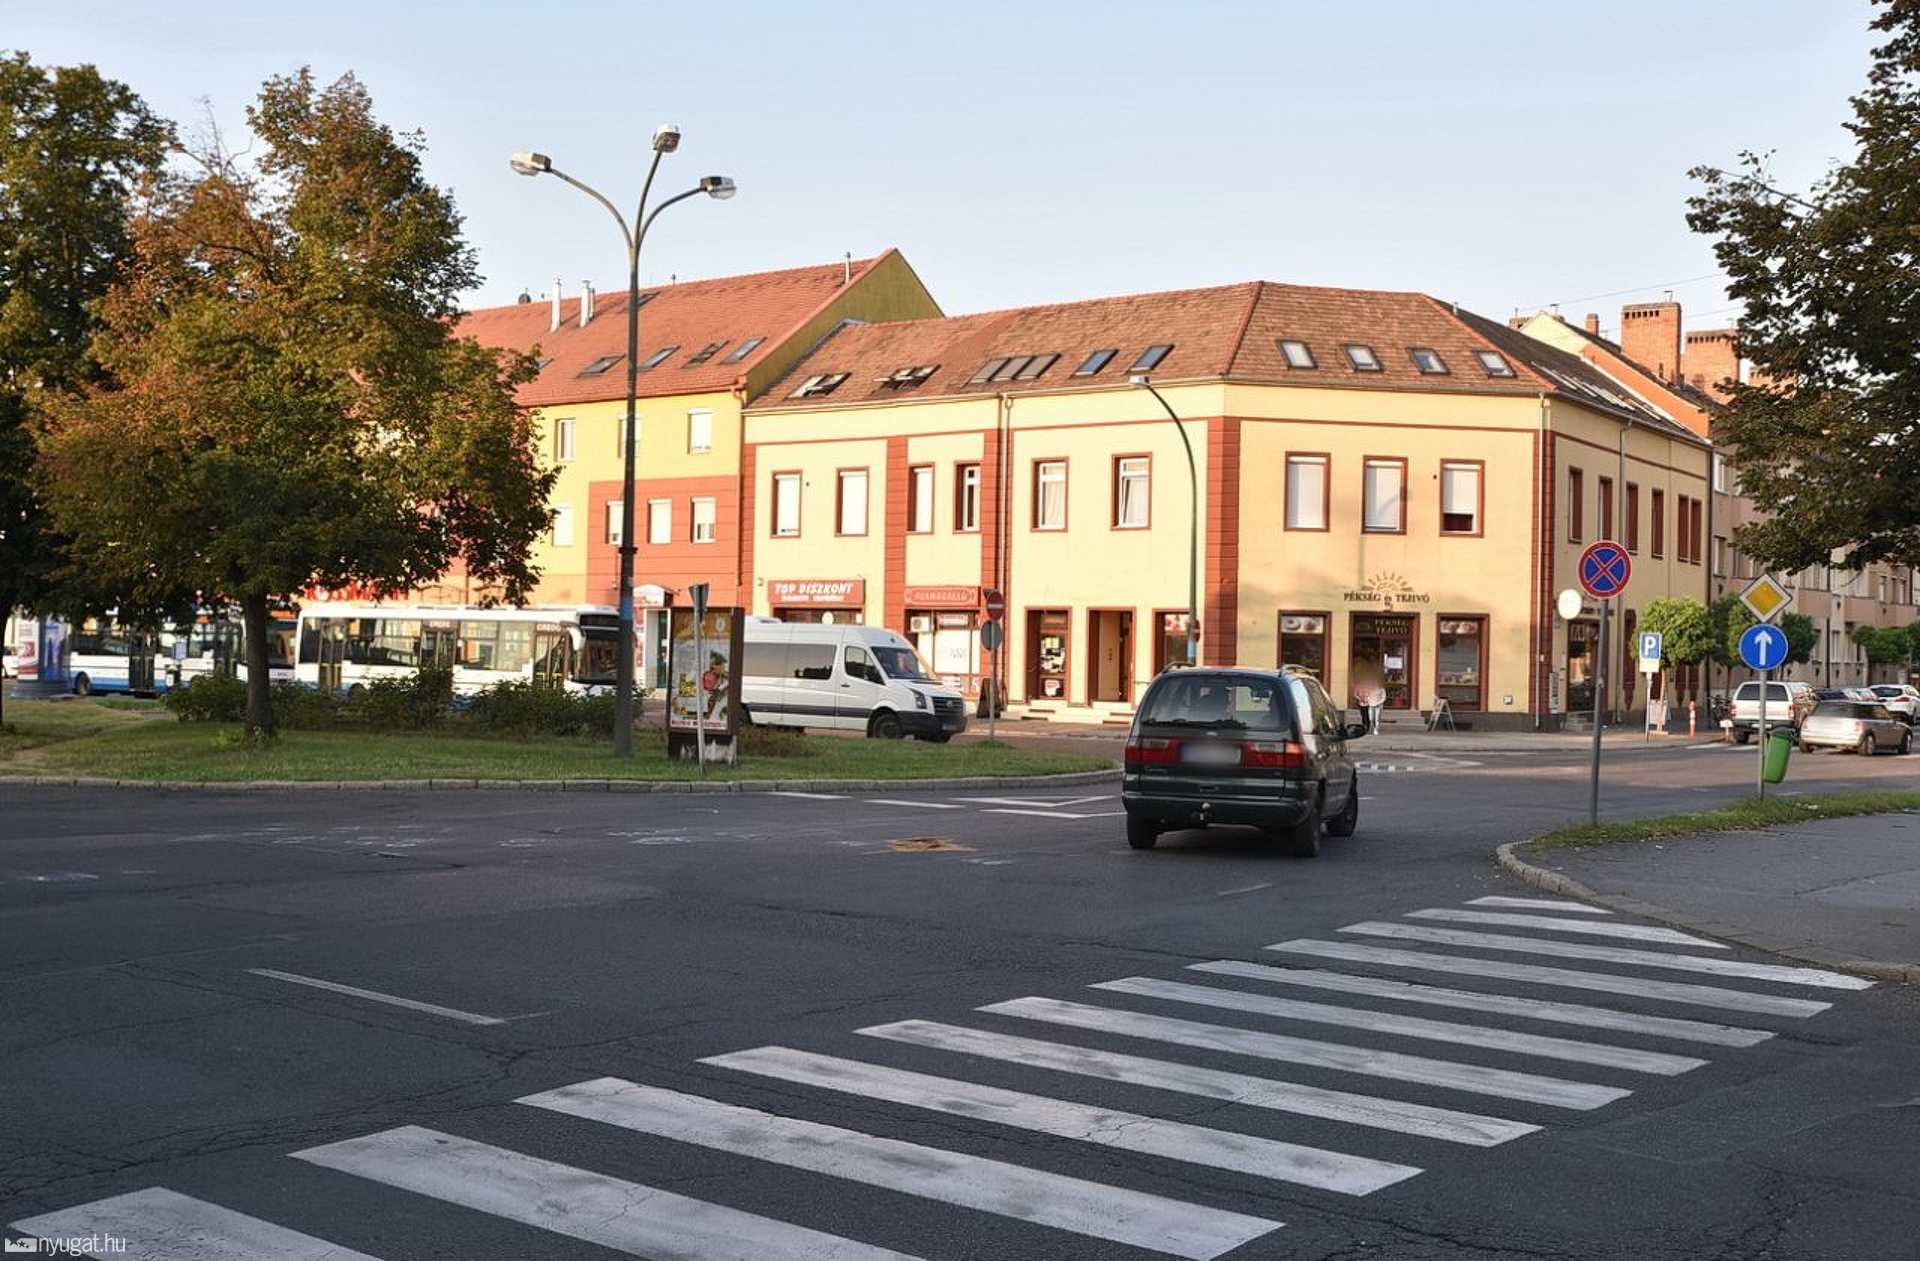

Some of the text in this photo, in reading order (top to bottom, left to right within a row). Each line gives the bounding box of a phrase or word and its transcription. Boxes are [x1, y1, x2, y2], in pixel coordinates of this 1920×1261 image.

[774, 582, 854, 594] TOP DISZKONT
[1343, 591, 1380, 601] PÉKSÉG
[1645, 636, 1656, 656] P
